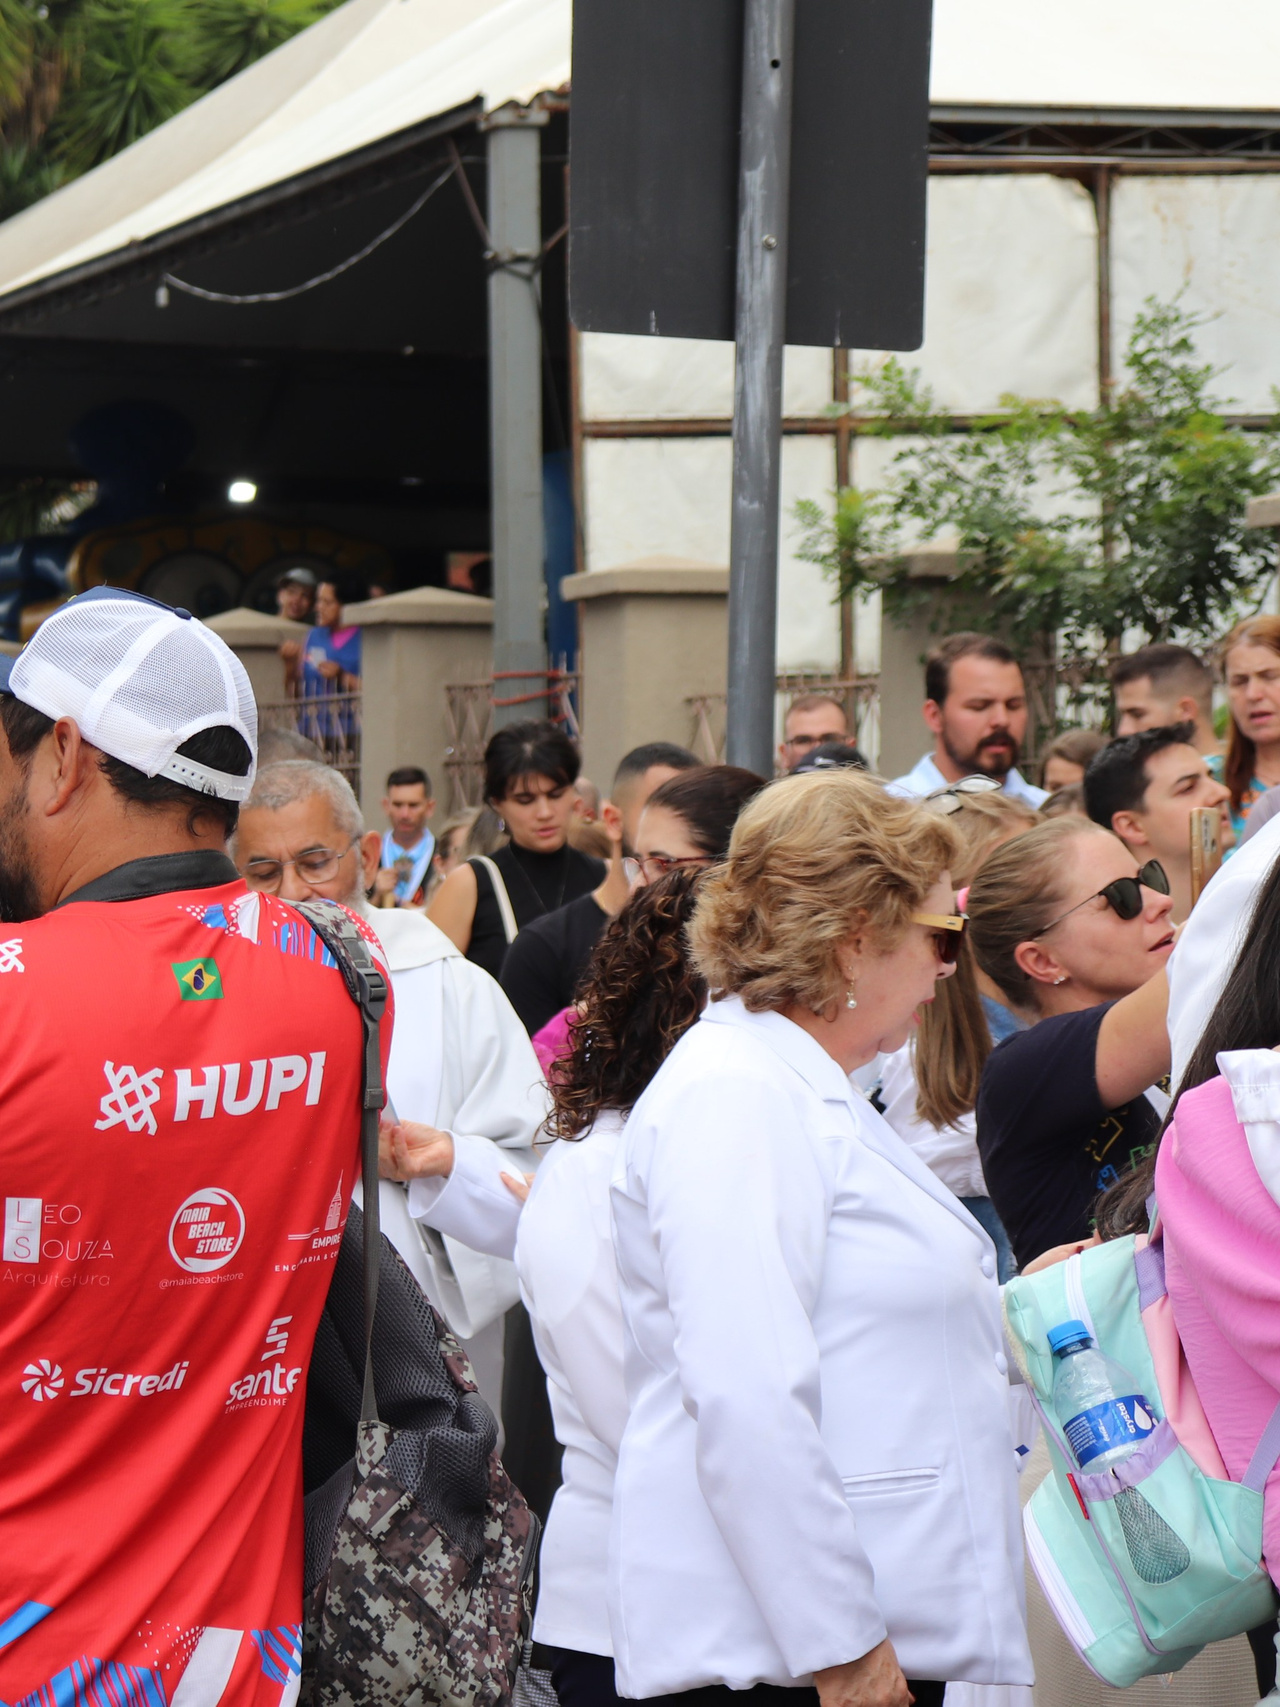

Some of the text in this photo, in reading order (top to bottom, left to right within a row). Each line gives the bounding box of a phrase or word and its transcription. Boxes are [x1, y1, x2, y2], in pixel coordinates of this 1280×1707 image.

[173, 1051, 327, 1122] HUPI
[179, 1206, 211, 1224] MAIA
[187, 1221, 226, 1239] BEACH
[195, 1236, 235, 1254] STORE
[311, 1232, 342, 1250] EMPIRE
[2, 1268, 111, 1288] Arquitetura
[158, 1272, 244, 1290] @maiabeachstore
[69, 1360, 190, 1397] Sicredi
[1116, 1402, 1136, 1434] crystal
